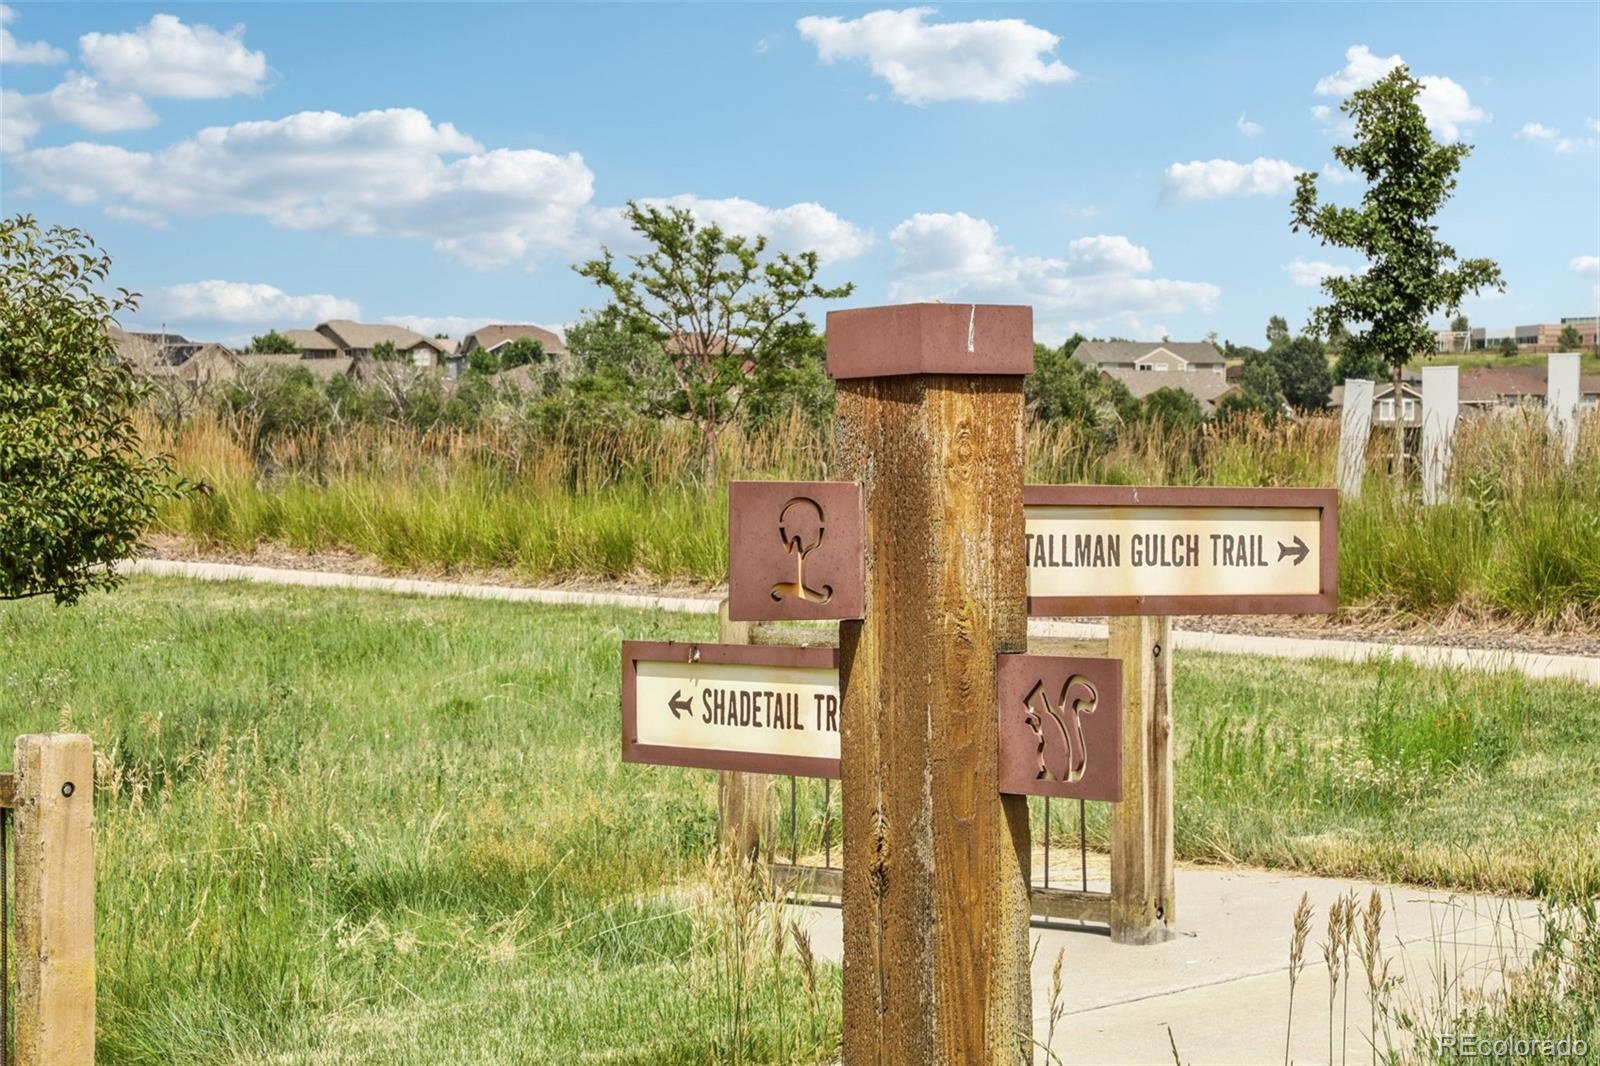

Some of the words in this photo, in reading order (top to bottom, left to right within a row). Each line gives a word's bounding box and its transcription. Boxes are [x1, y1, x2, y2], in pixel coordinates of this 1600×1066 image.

[1025, 533, 1121, 568] TALLMAN
[1131, 533, 1200, 568] GULCH
[1210, 533, 1269, 568] TRAIL
[702, 687, 804, 731] SHADETAIL
[814, 693, 841, 733] TR
